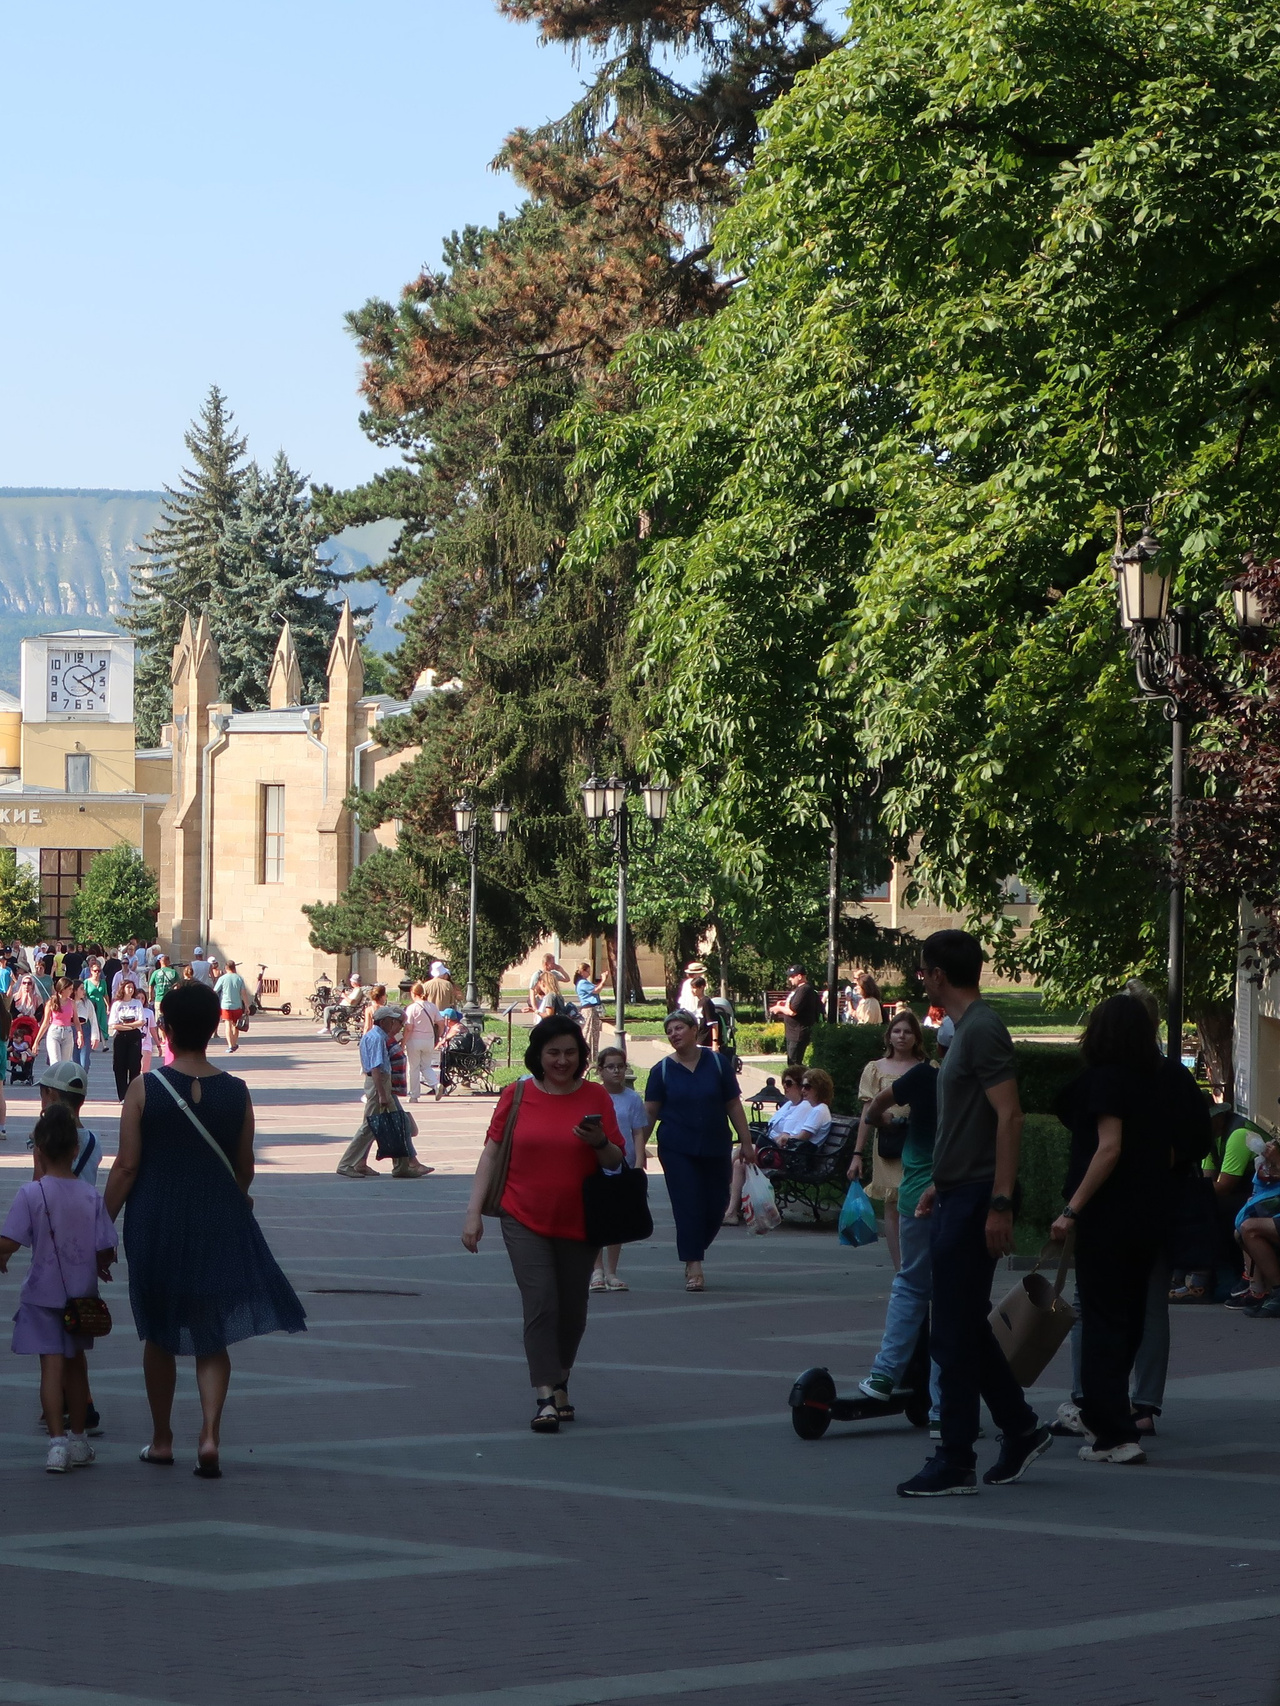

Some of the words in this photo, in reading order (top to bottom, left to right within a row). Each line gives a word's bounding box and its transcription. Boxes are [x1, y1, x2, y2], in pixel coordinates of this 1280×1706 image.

[64, 652, 70, 663] 11
[74, 652, 84, 663] 12
[51, 659, 61, 670] 10
[99, 660, 106, 670] 2
[51, 675, 58, 686] 9
[99, 676, 106, 687] 3
[51, 691, 58, 702] 8
[99, 692, 106, 703] 4
[63, 698, 70, 709] 7
[75, 699, 82, 710] 6
[87, 699, 94, 710] 5
